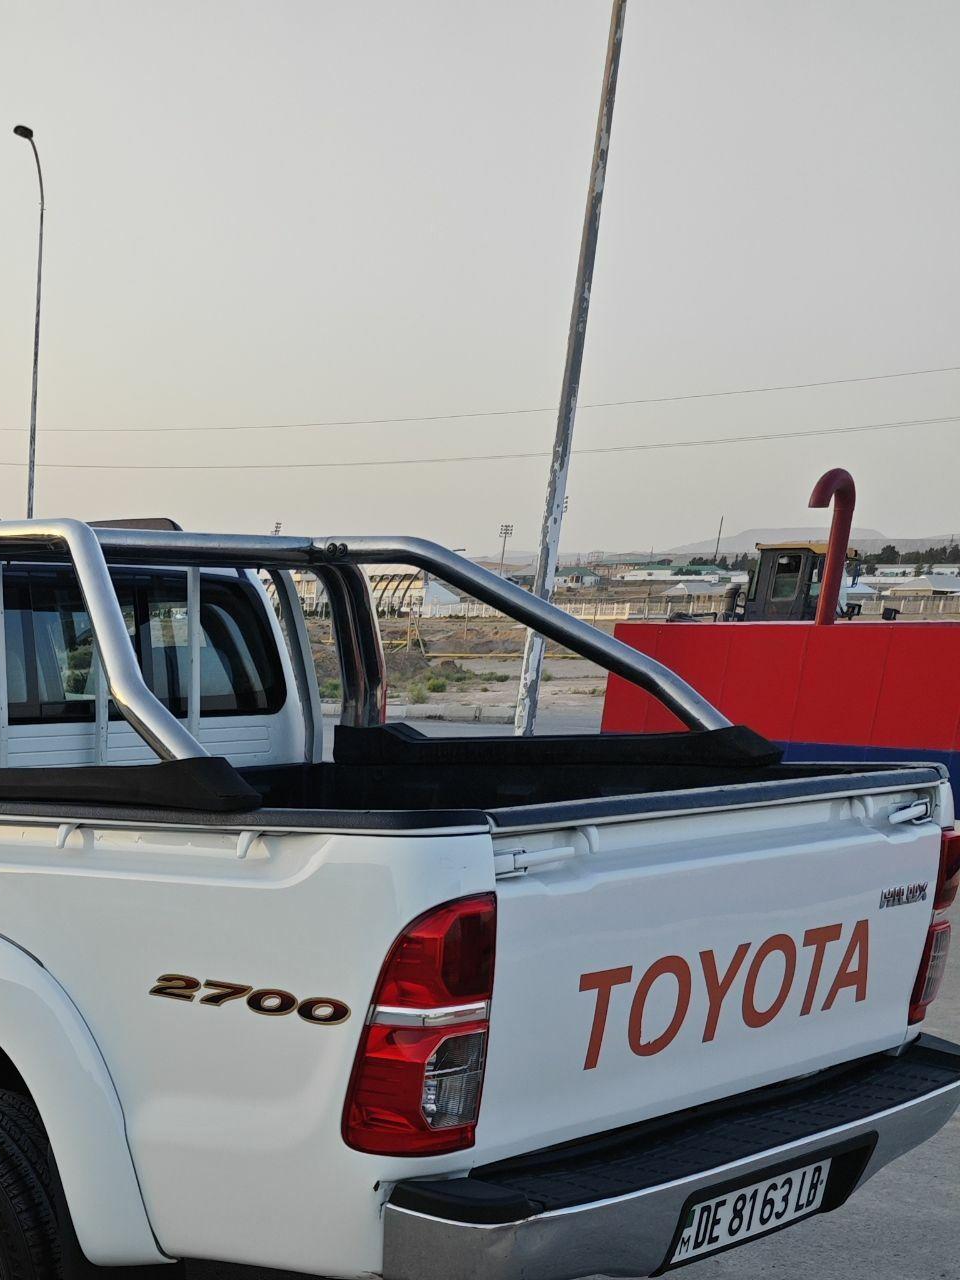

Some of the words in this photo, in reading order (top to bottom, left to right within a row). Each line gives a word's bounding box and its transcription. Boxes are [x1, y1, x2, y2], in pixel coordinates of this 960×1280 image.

[879, 881, 928, 909] HILUX
[149, 974, 351, 1025] 2700
[579, 919, 869, 1070] TOYOTA
[693, 1199, 727, 1250] DE
[728, 1177, 792, 1236] 8163
[794, 1165, 822, 1213] LB
